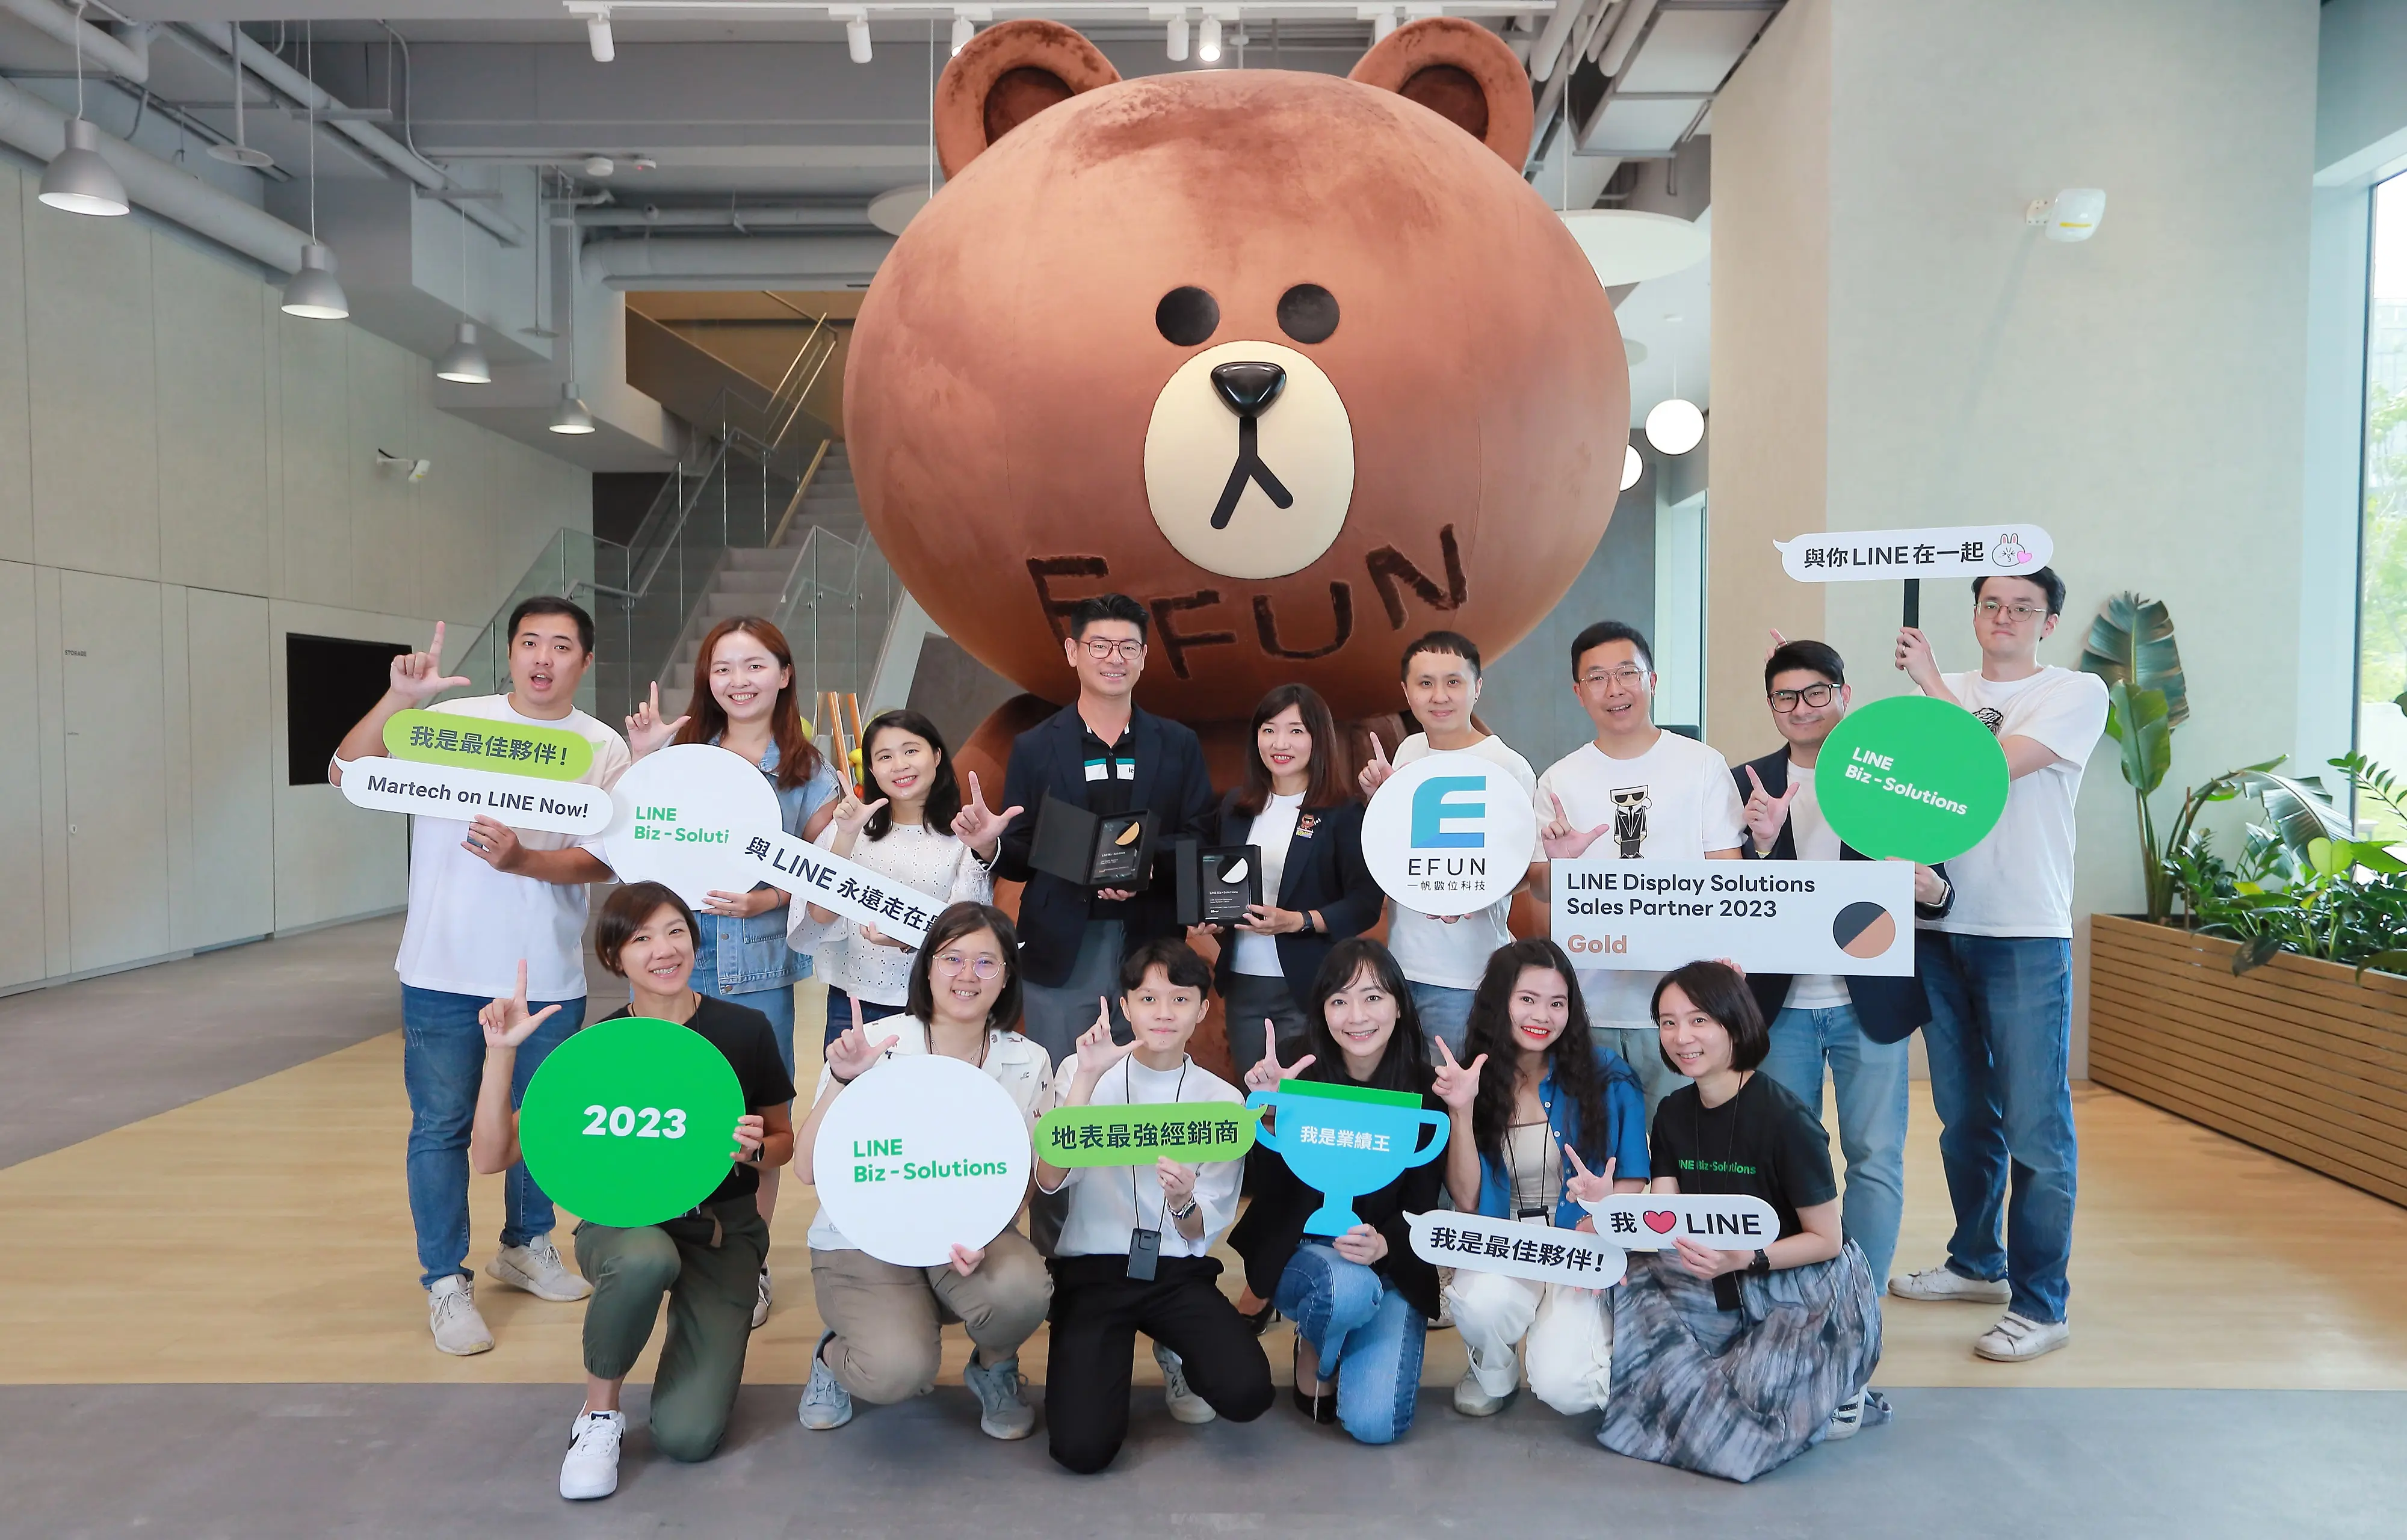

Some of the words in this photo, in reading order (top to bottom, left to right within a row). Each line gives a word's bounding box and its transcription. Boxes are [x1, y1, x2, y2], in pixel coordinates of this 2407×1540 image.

[409, 725, 567, 766] 我是最佳夥伴!
[1852, 747, 1894, 771] LINE
[368, 775, 451, 801] Martech
[457, 791, 481, 804] on
[487, 791, 534, 812] LINE
[539, 798, 589, 818] Now!
[635, 806, 677, 822] LINE
[744, 836, 770, 861] 與
[772, 848, 837, 890] LINE
[1408, 858, 1485, 876] EFUN
[1407, 880, 1486, 891] 一帆數位科技
[1568, 873, 1618, 890] LINE
[1624, 873, 1705, 896] Display
[1710, 874, 1815, 893] Solutions
[1567, 898, 1624, 915] Sales
[1630, 898, 1714, 916] Partner
[1719, 899, 1776, 917] 2023
[1567, 934, 1627, 954] Gold
[582, 1104, 687, 1139] 2023
[1051, 1119, 1238, 1150] 地表最強經銷商
[1300, 1126, 1391, 1152] 我是業績王
[853, 1138, 903, 1158] LINE
[1610, 1212, 1637, 1234] 我
[1686, 1213, 1762, 1235] LINE
[1429, 1225, 1605, 1274] 我是最佳夥伴!
